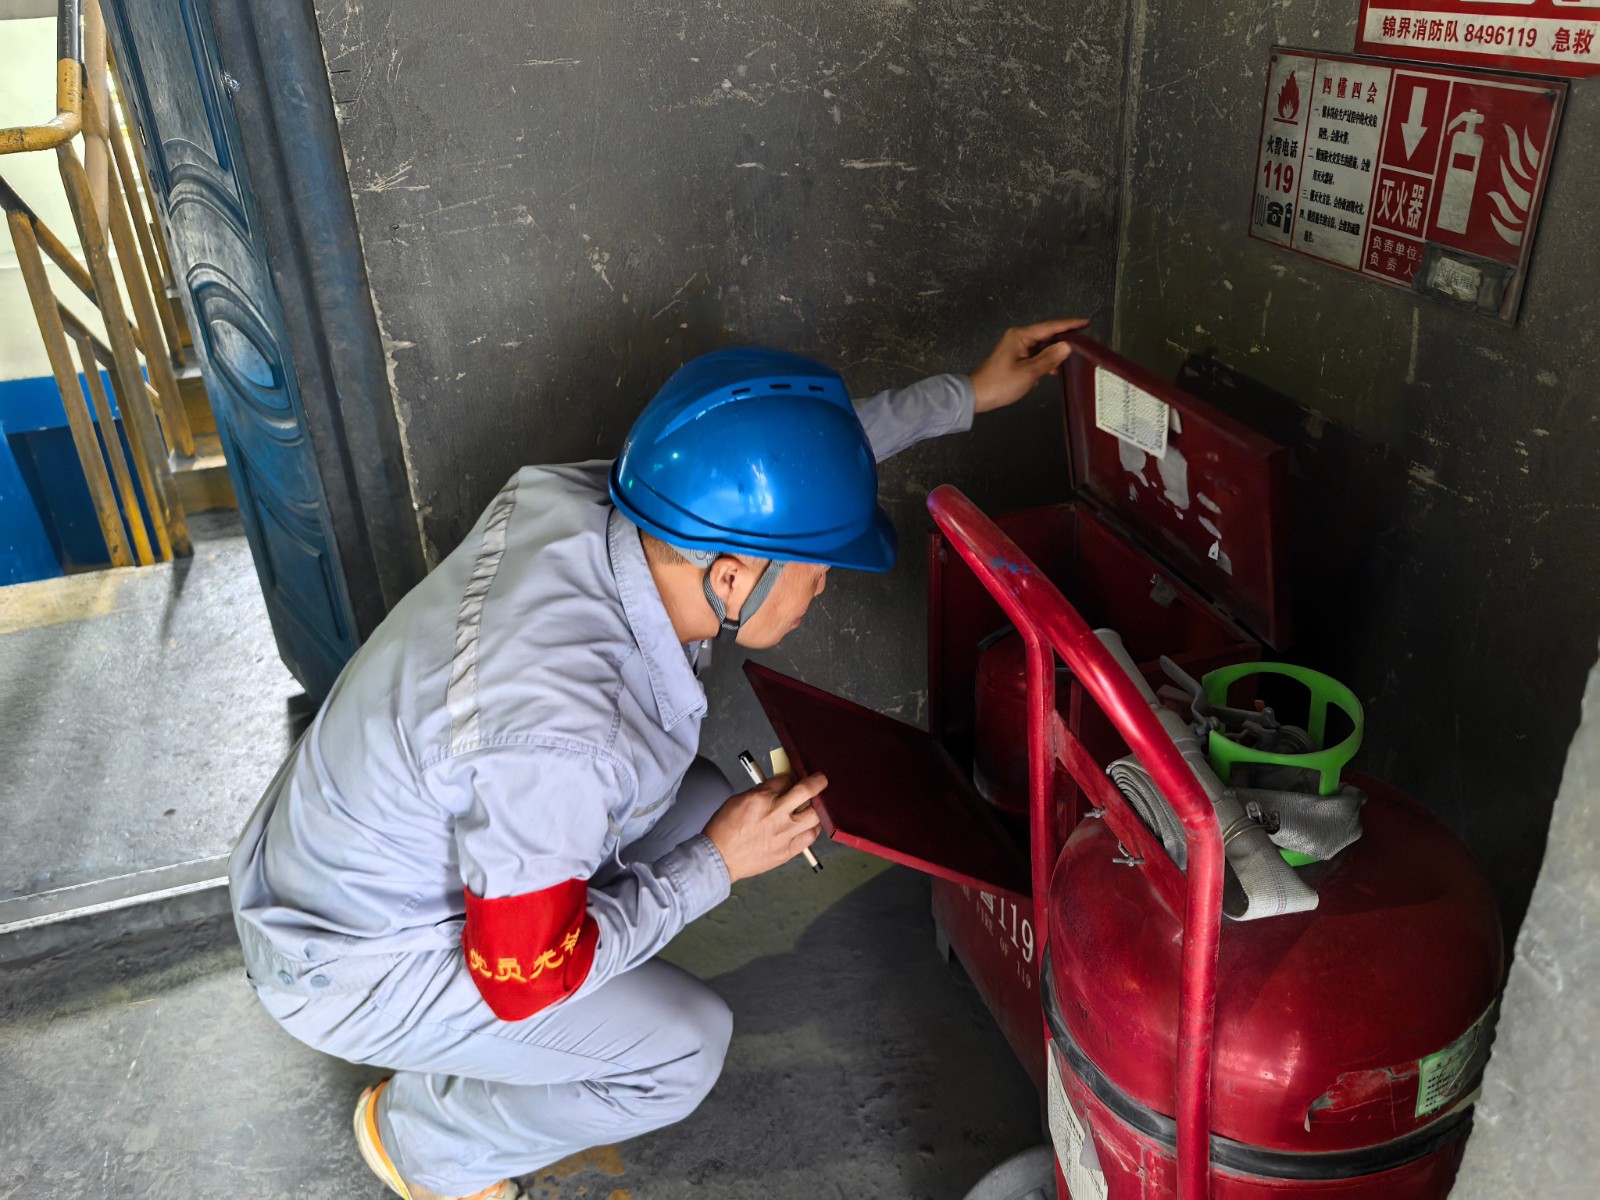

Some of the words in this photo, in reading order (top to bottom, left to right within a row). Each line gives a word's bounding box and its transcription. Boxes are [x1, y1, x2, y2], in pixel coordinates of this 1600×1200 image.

[1382, 15, 1459, 43] 锦界消防队
[1464, 23, 1538, 48] 8496119
[1551, 27, 1595, 55] 急救
[1322, 76, 1378, 104] 四懂四会
[1266, 135, 1299, 158] 火警电话
[1264, 160, 1294, 194] 119
[1377, 179, 1425, 230] 灭火器
[1369, 251, 1414, 277] 负责人
[980, 891, 1034, 963] 119
